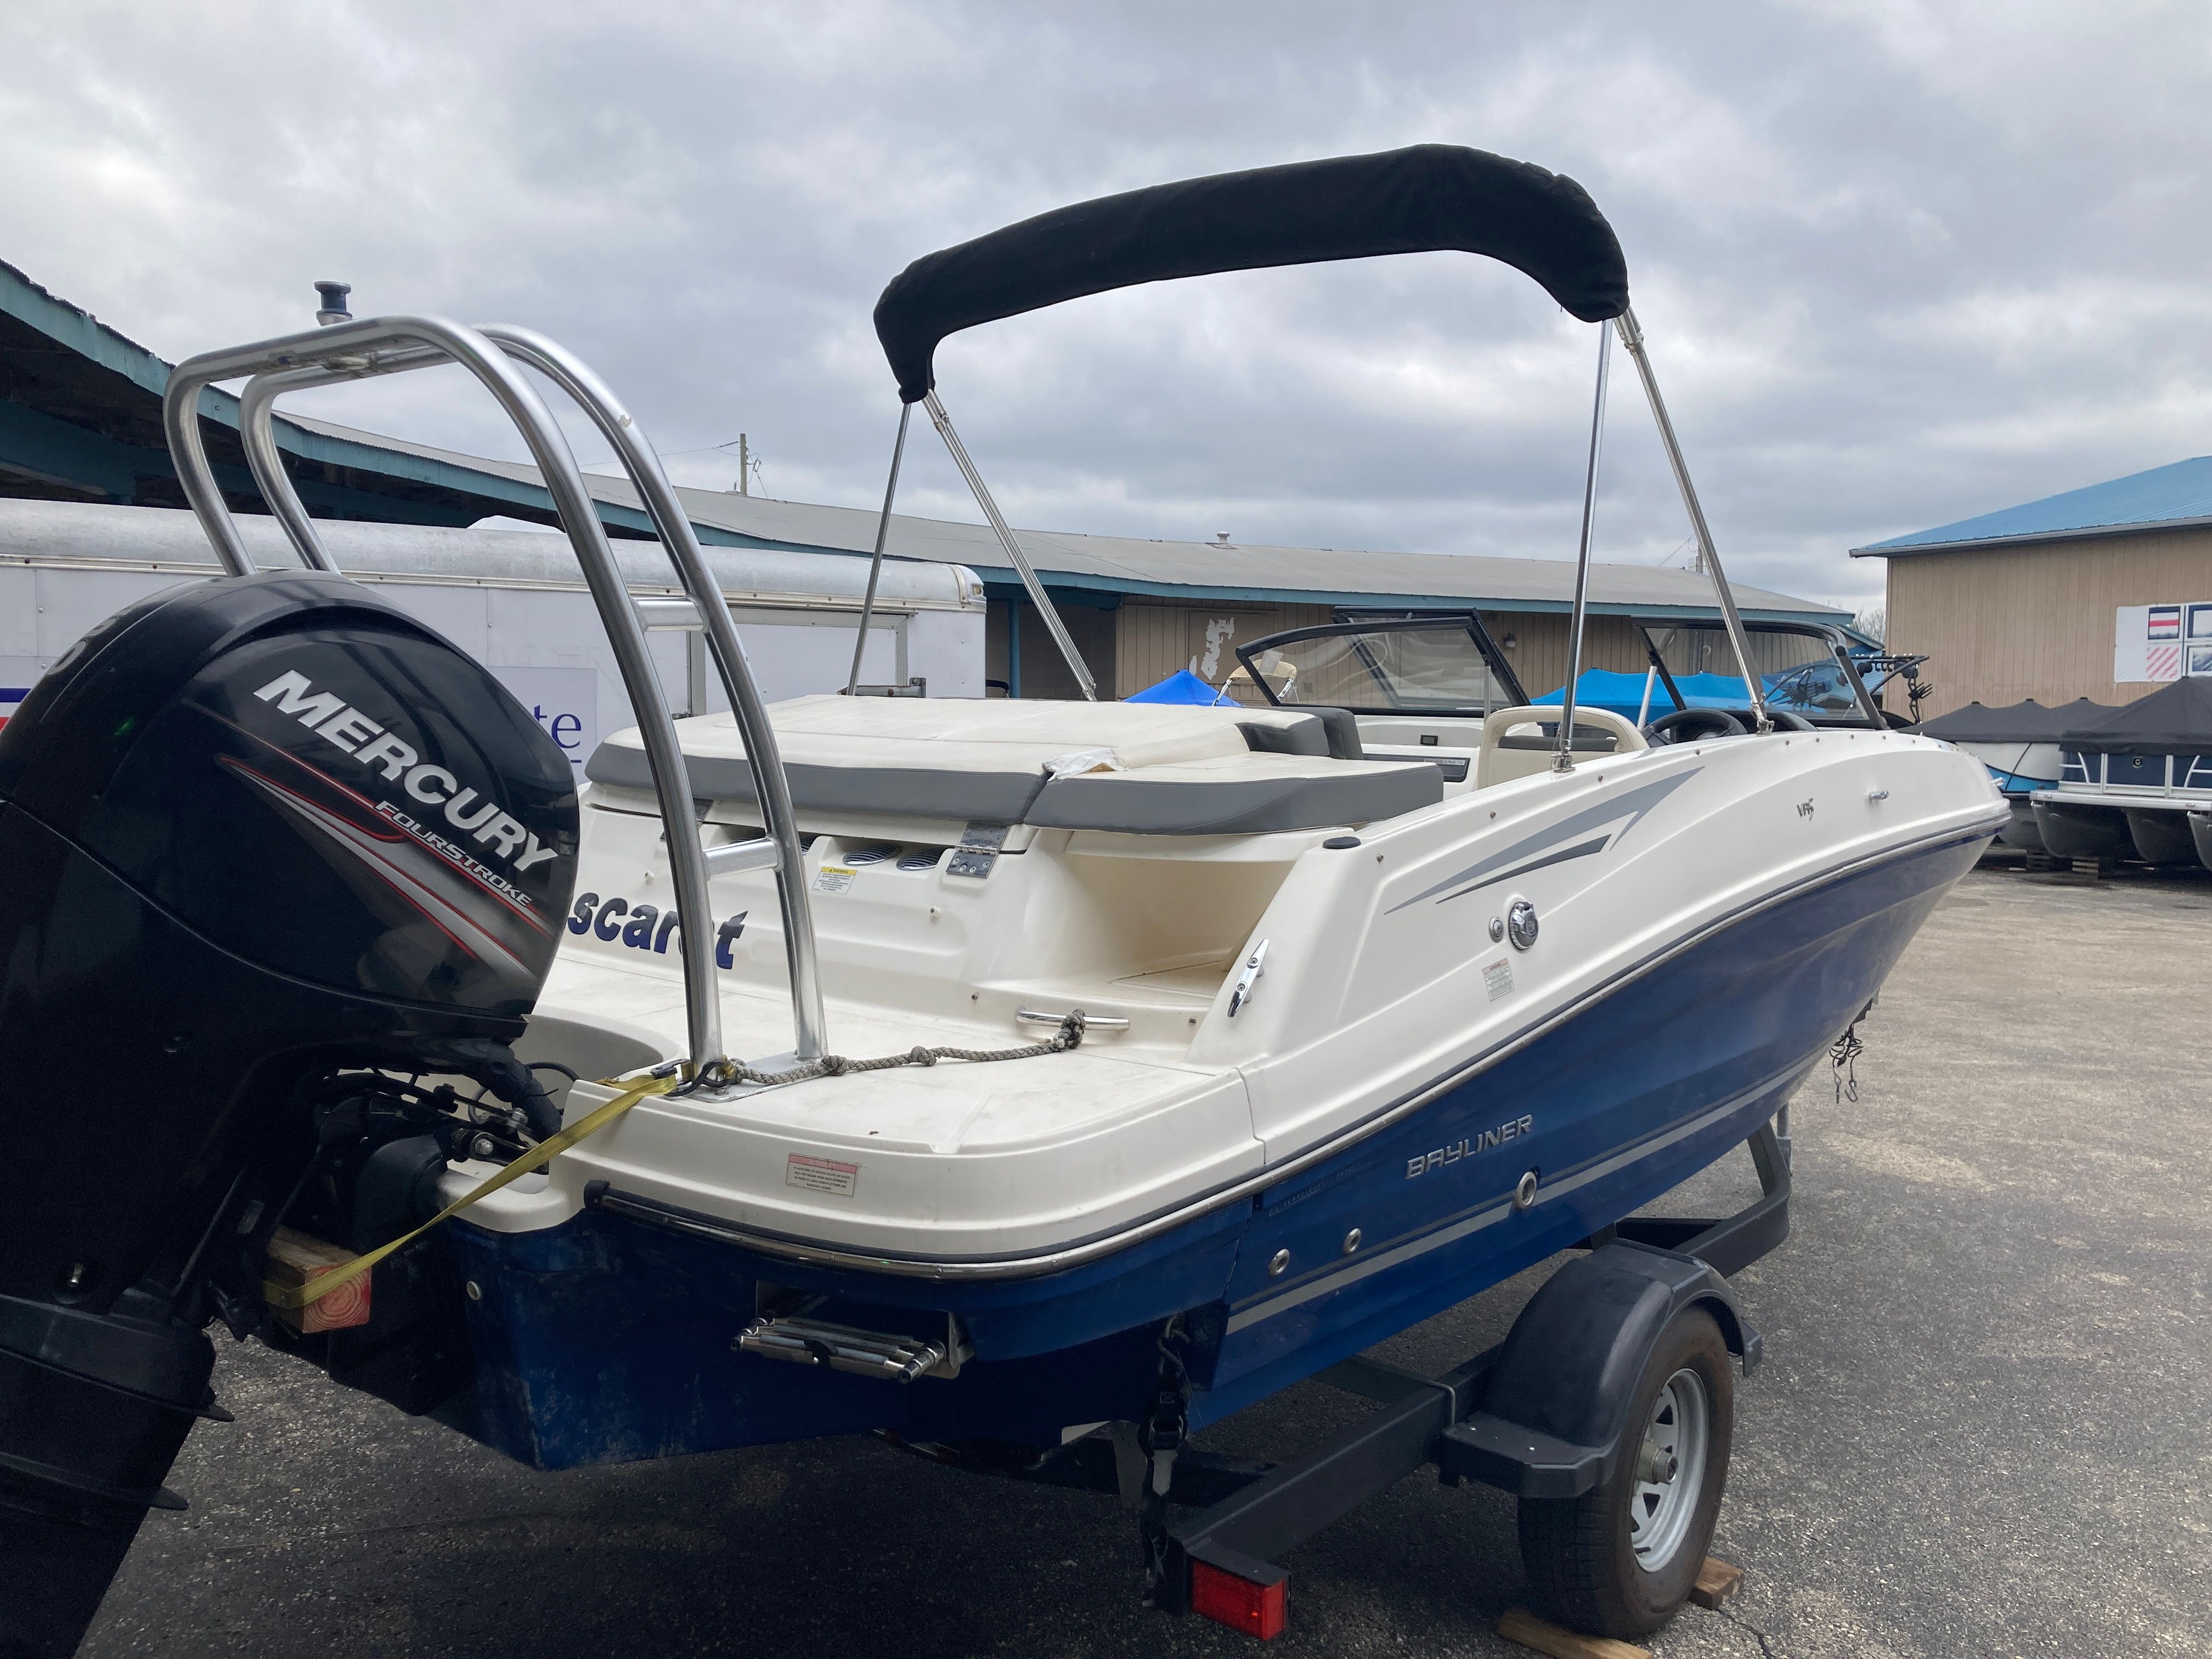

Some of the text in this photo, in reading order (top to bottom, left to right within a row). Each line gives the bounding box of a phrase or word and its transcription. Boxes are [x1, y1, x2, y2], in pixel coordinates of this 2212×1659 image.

[253, 669, 558, 872] MERCURY
[1797, 798, 1814, 821] VR5
[373, 800, 533, 907] FOURSTROKE
[567, 892, 748, 970] scart
[1405, 1114, 1533, 1181] BAYLINER
